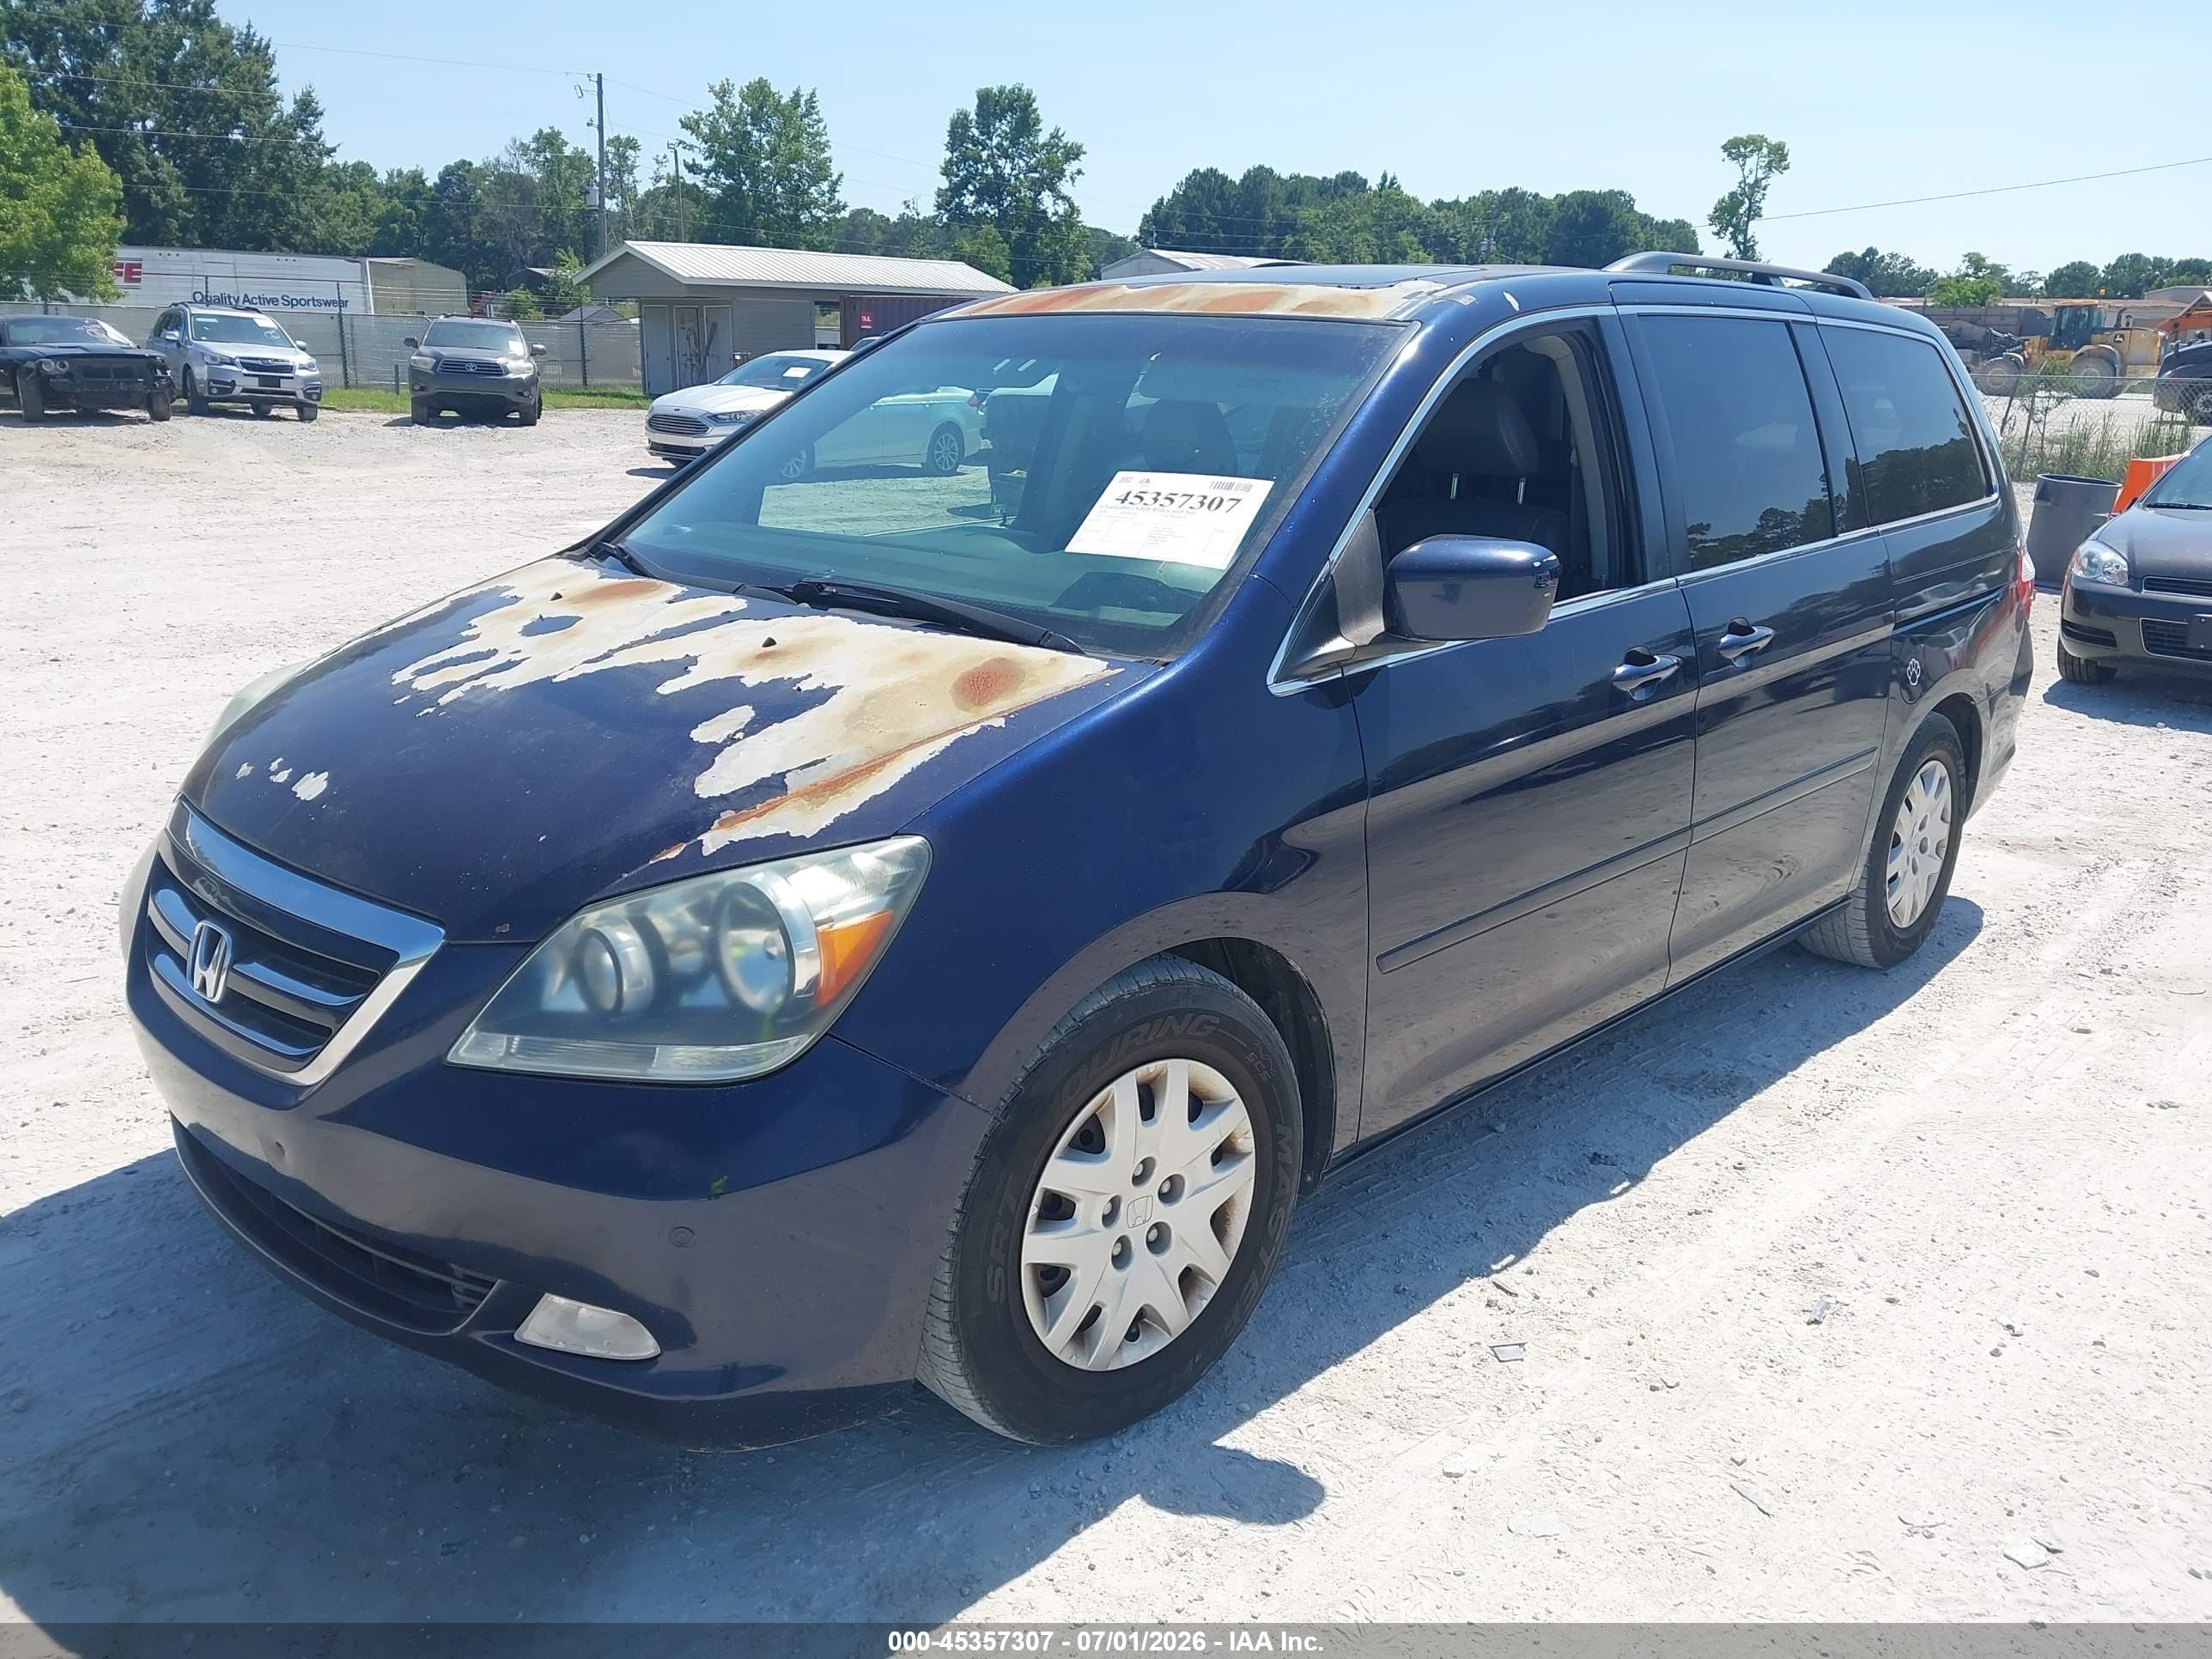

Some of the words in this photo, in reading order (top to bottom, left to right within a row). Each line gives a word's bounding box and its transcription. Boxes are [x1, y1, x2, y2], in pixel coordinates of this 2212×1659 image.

[192, 291, 240, 307] Quality
[242, 294, 279, 307] Active
[281, 295, 349, 308] Sportswear
[1115, 490, 1243, 514] 45357307
[1060, 1012, 1221, 1109] OURING
